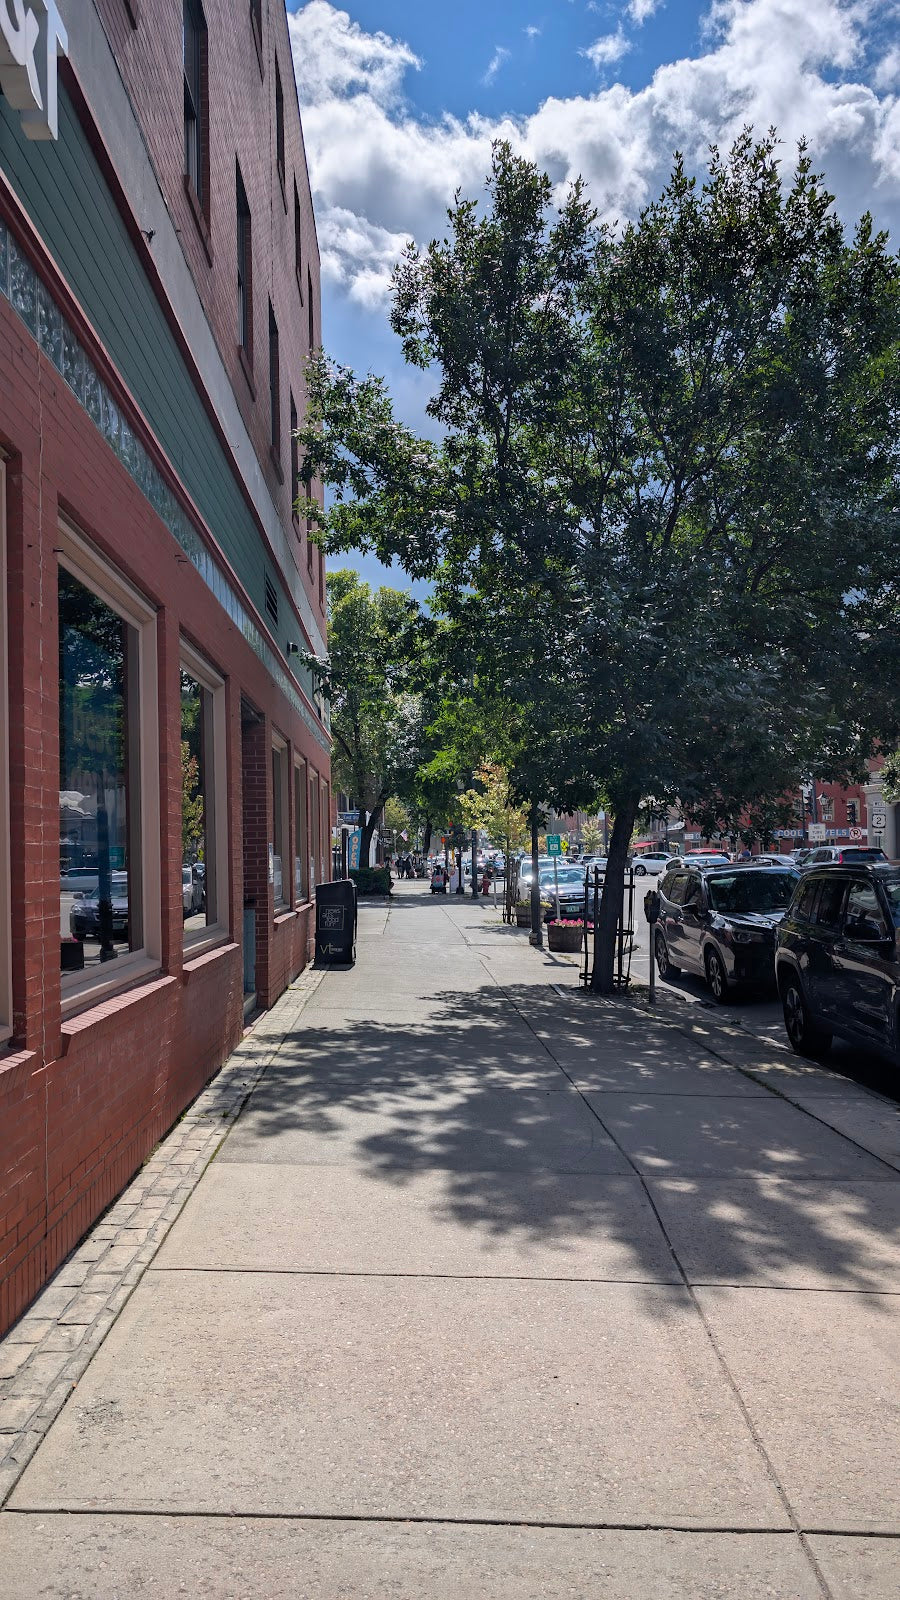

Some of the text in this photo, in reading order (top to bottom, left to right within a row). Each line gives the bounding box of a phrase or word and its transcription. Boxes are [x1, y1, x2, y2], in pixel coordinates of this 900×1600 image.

[876, 817, 882, 825] 2
[777, 829, 804, 837] COOL
[351, 835, 359, 868] OPEN
